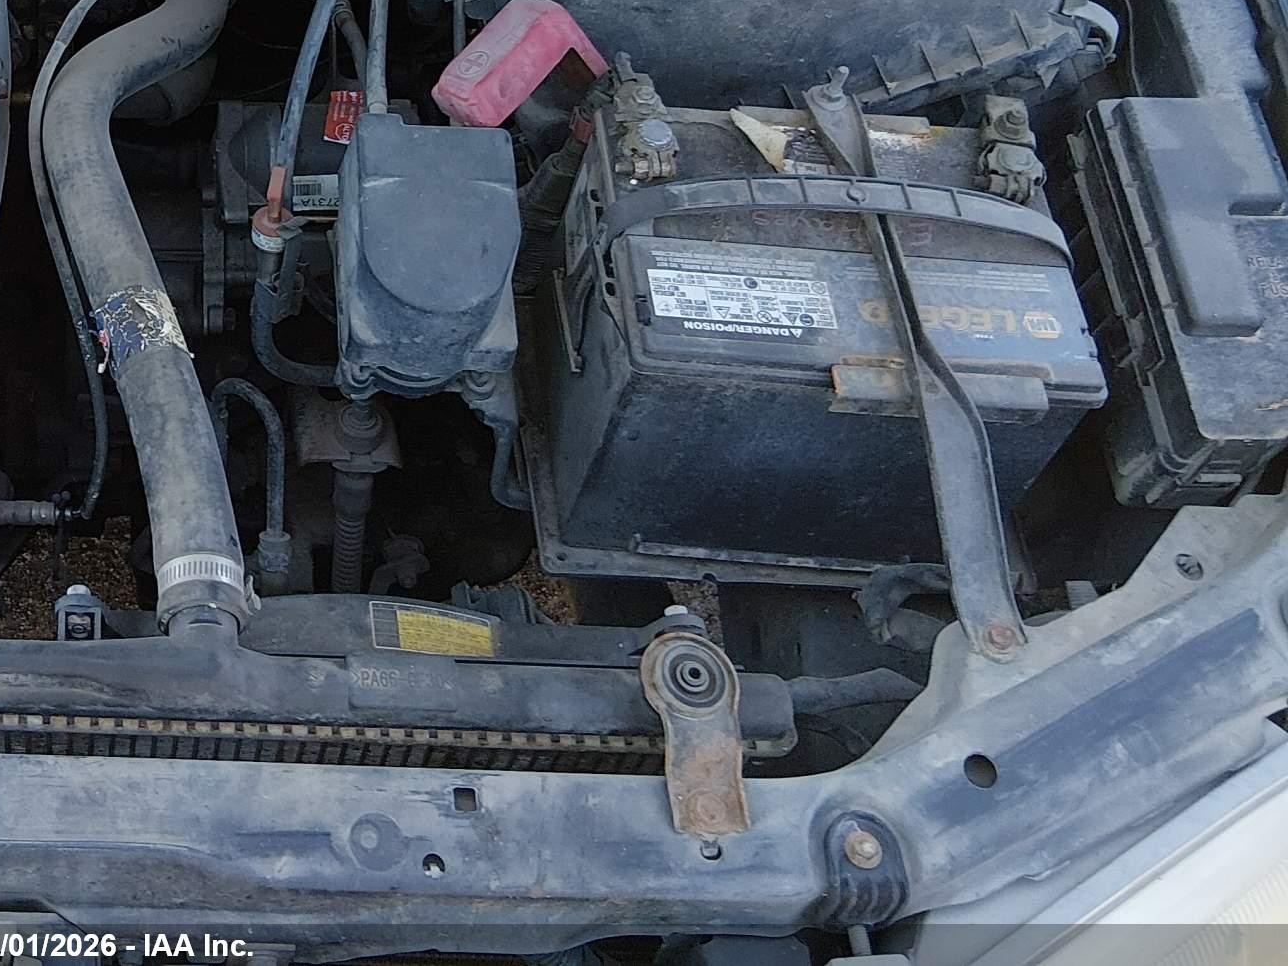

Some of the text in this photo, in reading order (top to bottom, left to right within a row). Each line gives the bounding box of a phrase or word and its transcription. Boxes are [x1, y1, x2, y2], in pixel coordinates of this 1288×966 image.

[1256, 282, 1288, 299] FUS
[856, 297, 1016, 332] LEGED
[683, 320, 792, 337] DANGER/POISON
